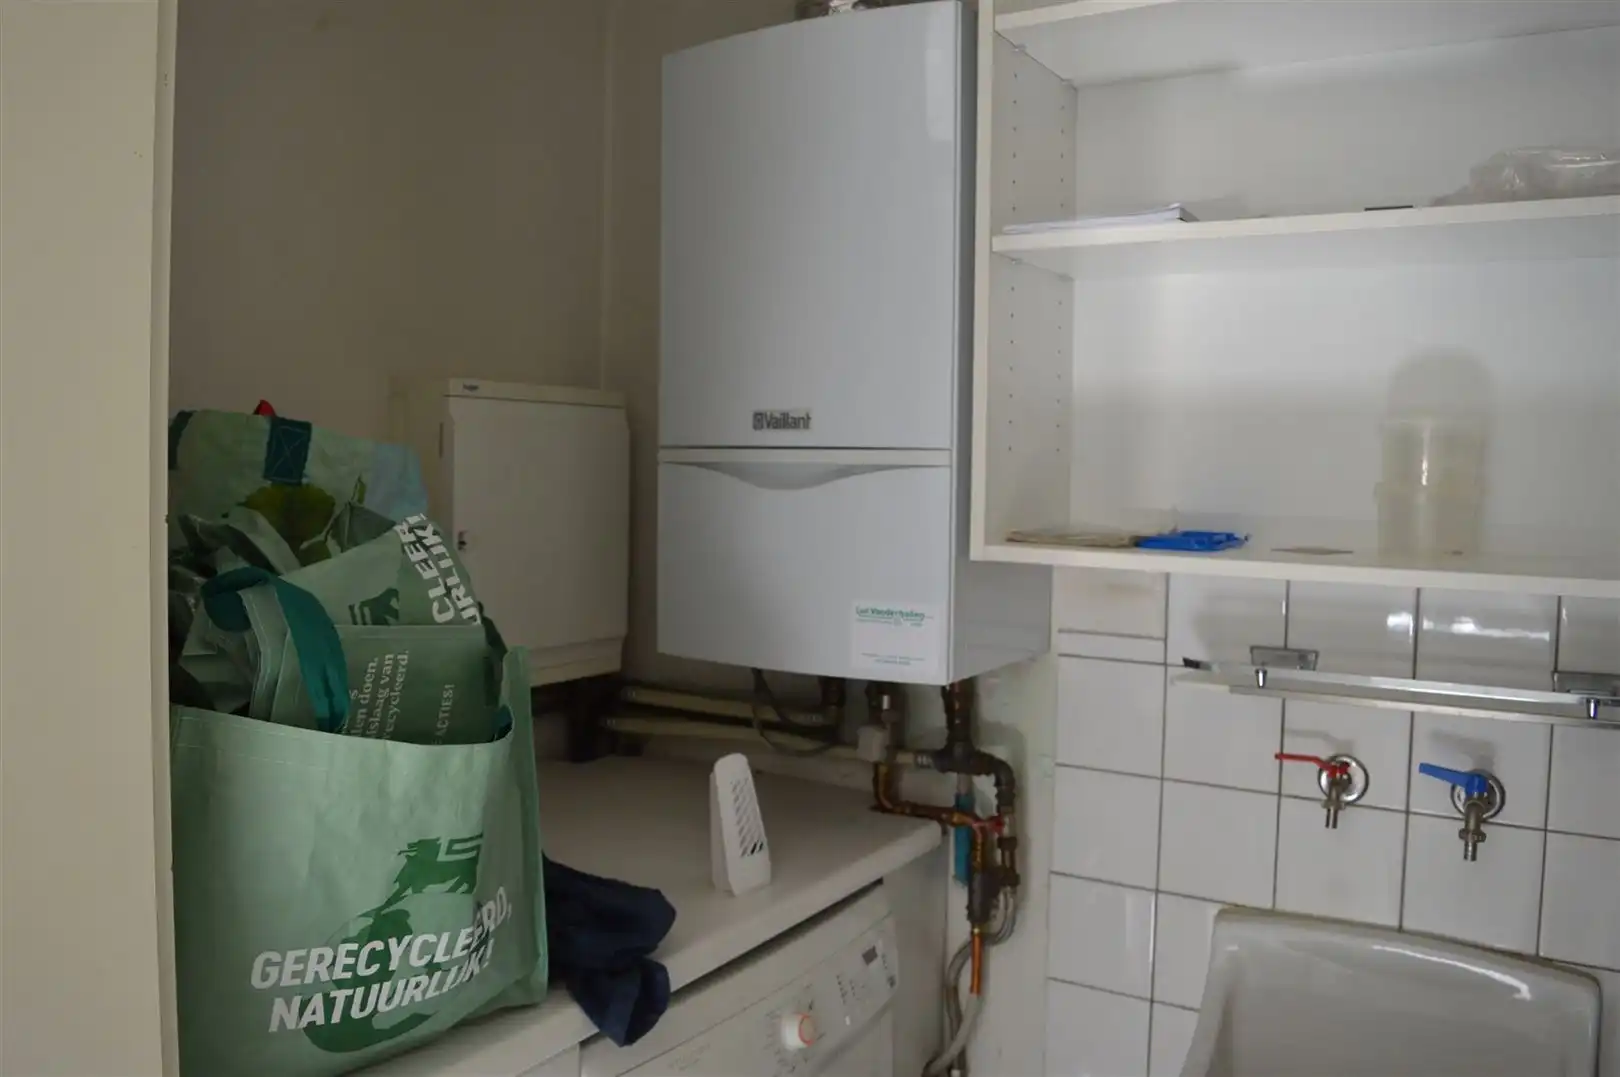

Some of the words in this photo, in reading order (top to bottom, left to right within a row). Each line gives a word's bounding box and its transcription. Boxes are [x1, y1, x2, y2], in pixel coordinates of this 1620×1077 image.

[764, 411, 812, 430] Vaillant
[358, 657, 379, 705] doen.
[380, 653, 395, 685] van
[268, 938, 494, 1033] NATUURLIJK!
